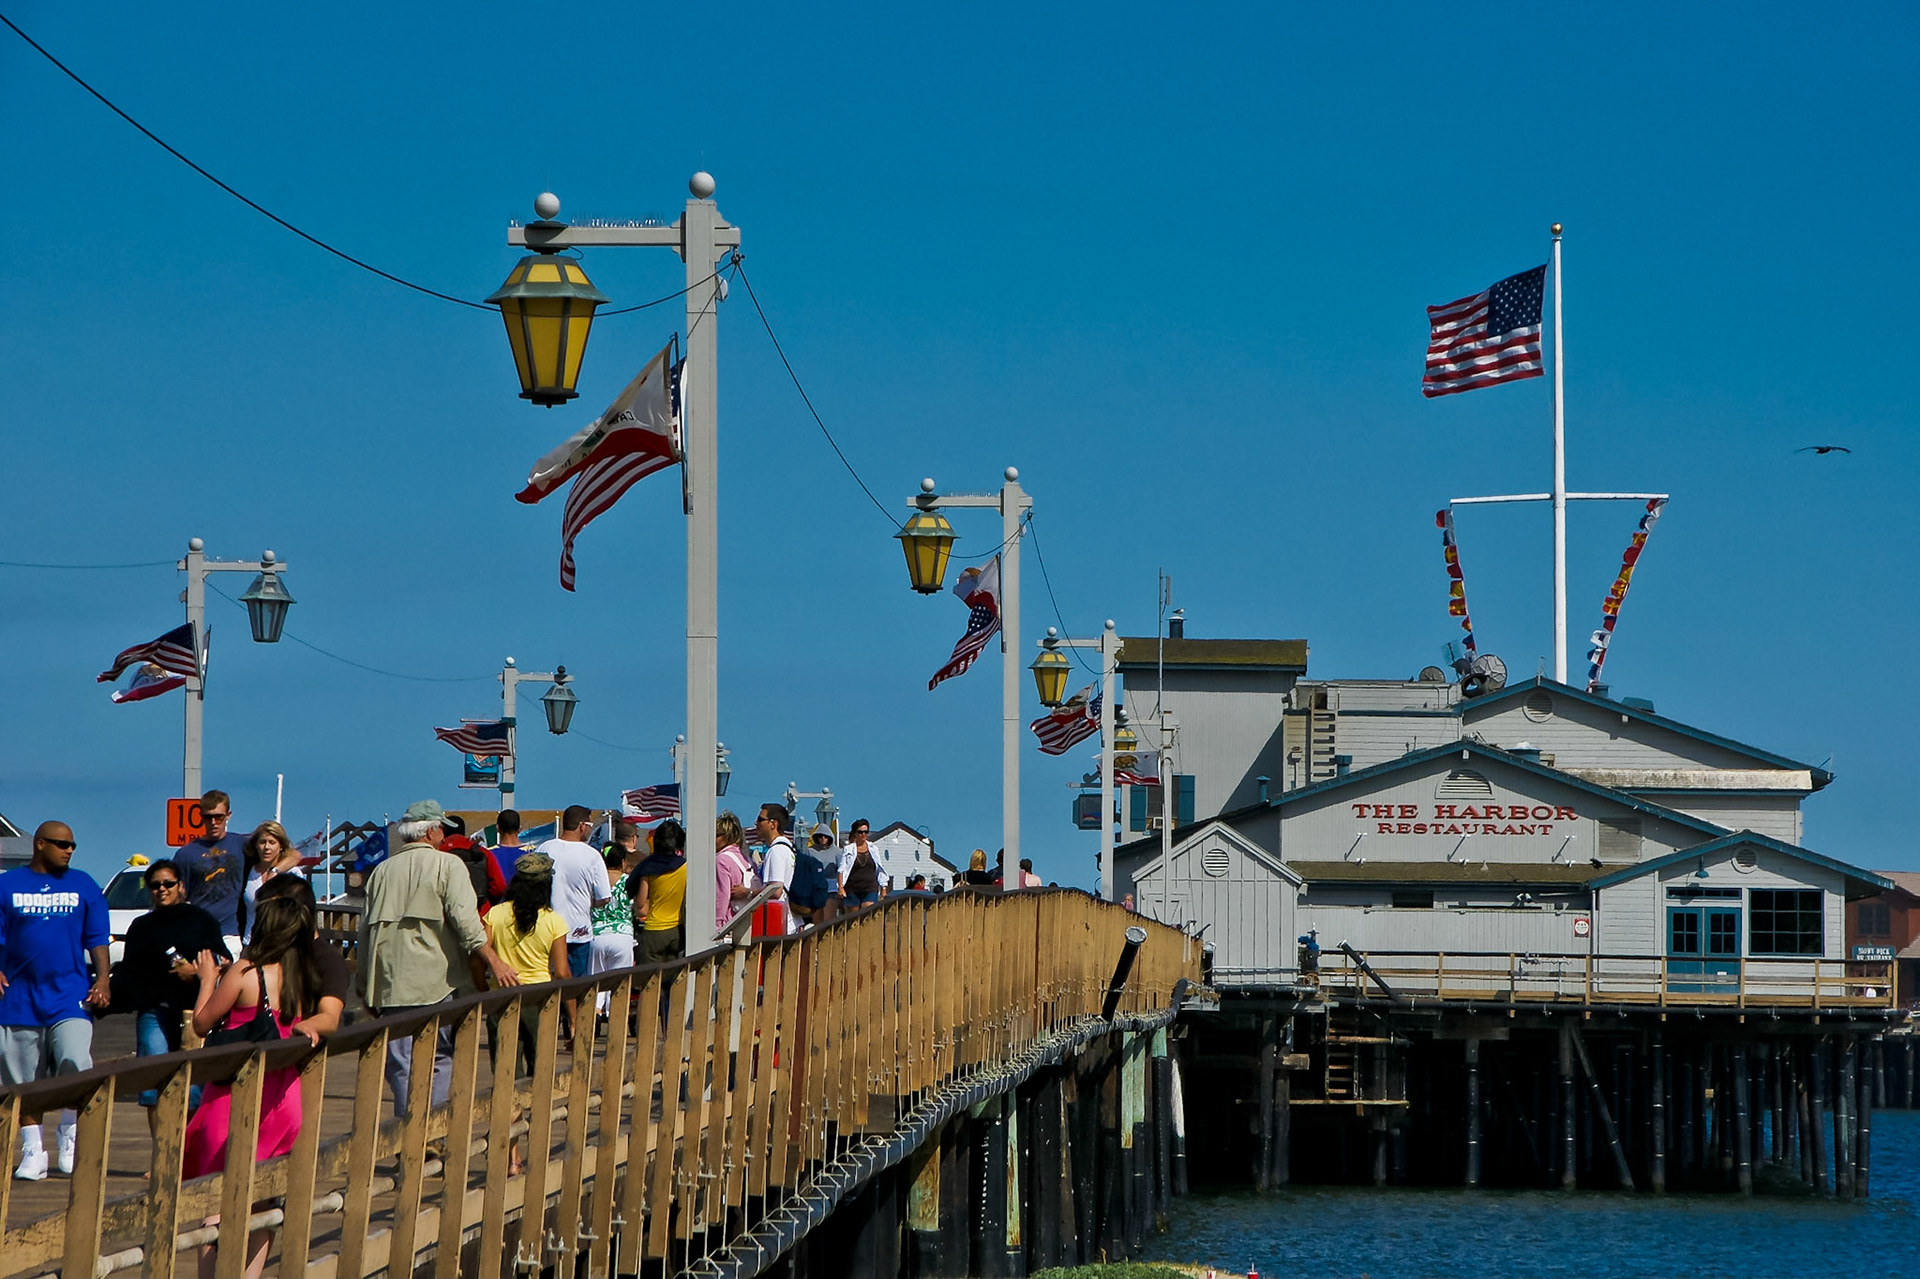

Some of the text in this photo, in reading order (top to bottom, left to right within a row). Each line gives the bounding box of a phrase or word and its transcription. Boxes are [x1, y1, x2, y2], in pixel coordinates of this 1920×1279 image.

[177, 803, 205, 829] 10
[1352, 803, 1579, 820] THE HARBOR
[1377, 823, 1553, 835] RESTAURANT
[177, 833, 205, 844] MP
[12, 892, 80, 908] DODGERS
